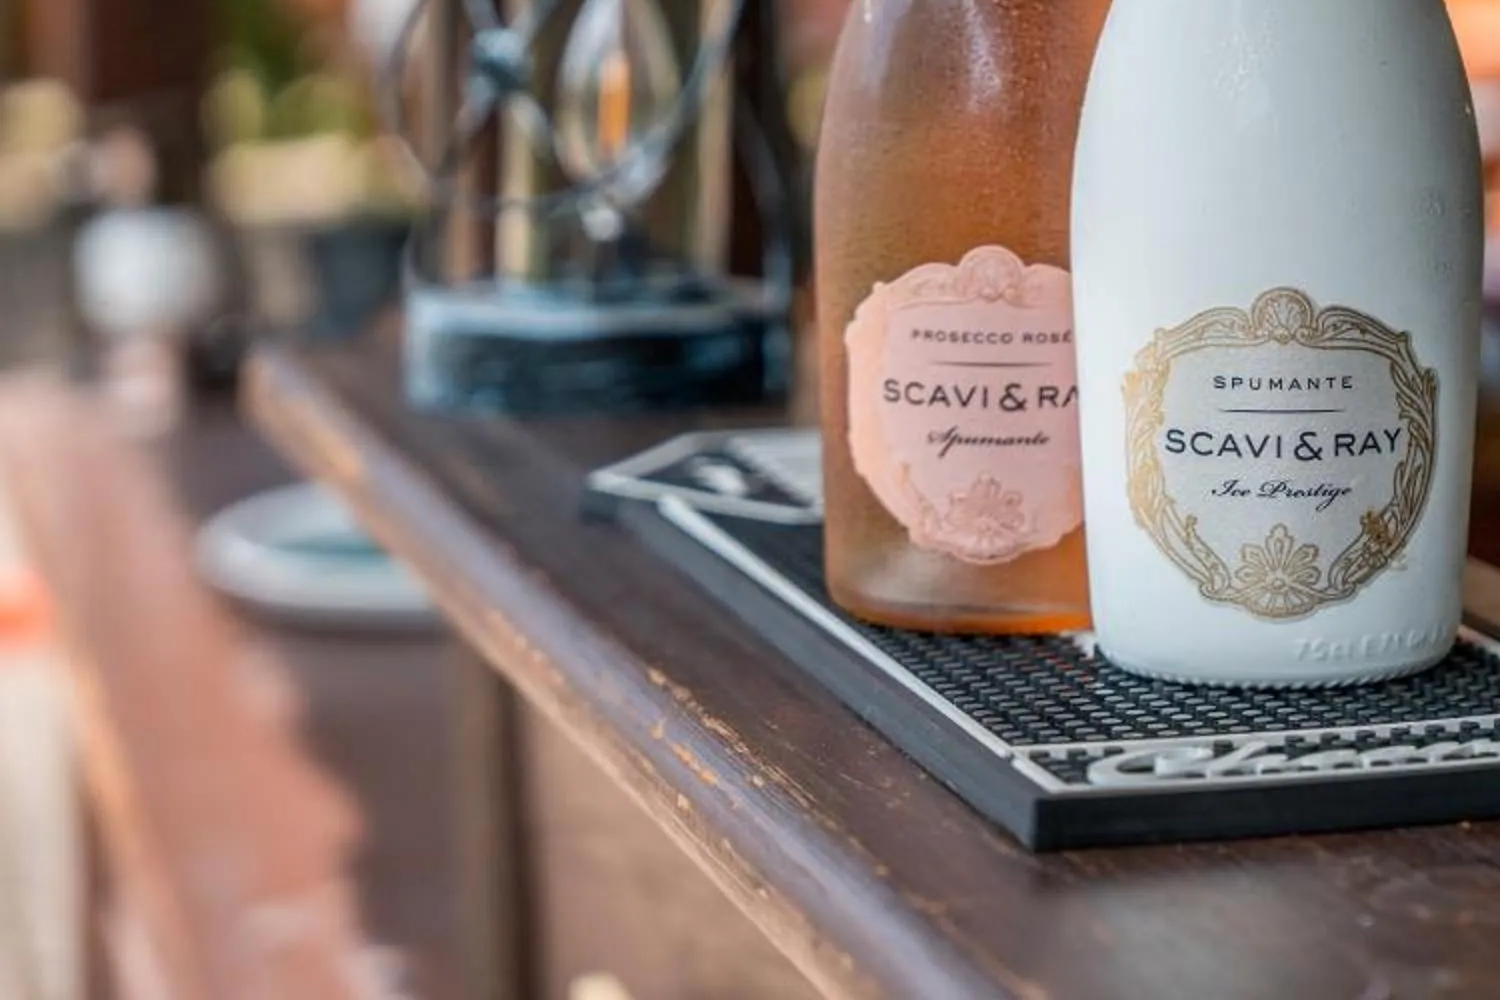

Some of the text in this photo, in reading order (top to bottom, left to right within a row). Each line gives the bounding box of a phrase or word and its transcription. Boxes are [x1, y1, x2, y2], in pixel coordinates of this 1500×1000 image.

[911, 328, 1014, 345] PROSECCO
[883, 378, 1079, 412] SCAVI & RA
[1213, 375, 1353, 390] SPUMANTE
[927, 425, 1051, 459] Spumante
[1165, 427, 1401, 461] SCAVI & RAY
[1211, 480, 1353, 512] Ice Prestige
